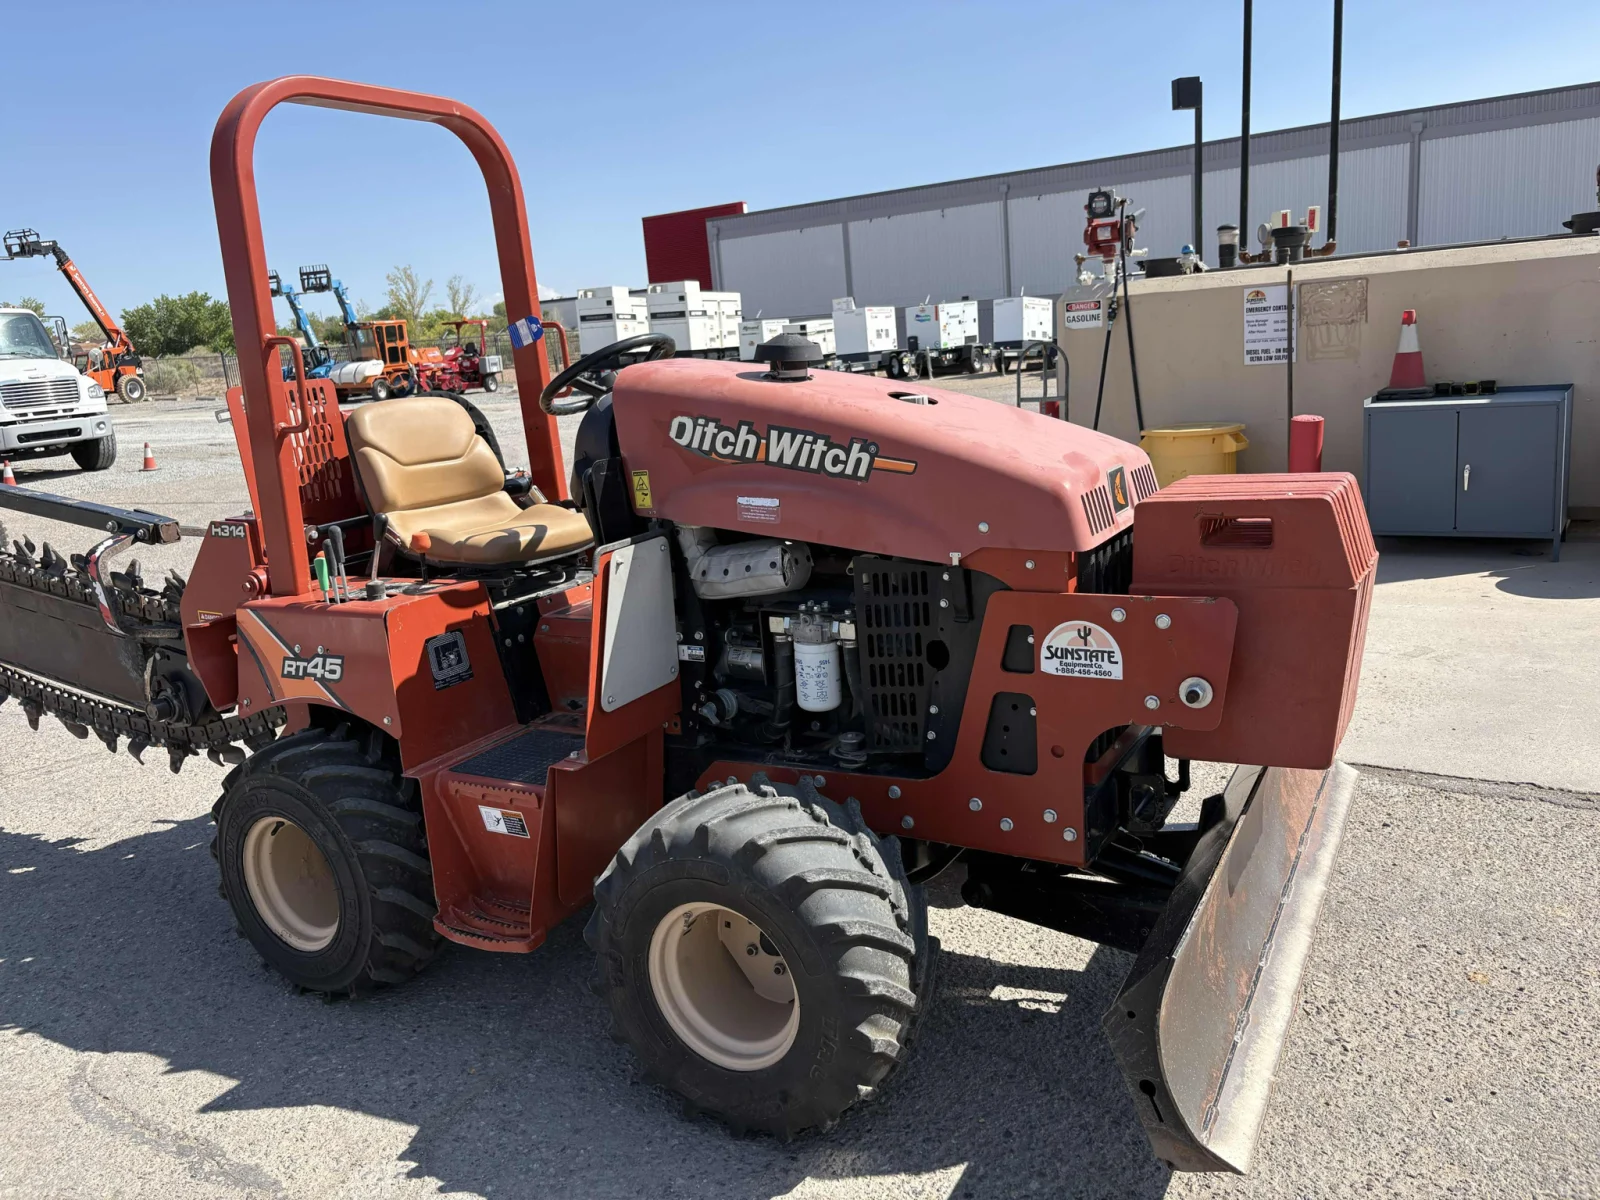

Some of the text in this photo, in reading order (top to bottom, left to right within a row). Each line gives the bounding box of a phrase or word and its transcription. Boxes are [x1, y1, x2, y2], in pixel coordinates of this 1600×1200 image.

[1071, 302, 1095, 311] DANGER
[1246, 305, 1271, 313] EMERGENCY
[1066, 313, 1101, 324] GASOLINE
[668, 415, 872, 478] Ditch Witch
[211, 524, 246, 538] H314
[1044, 645, 1119, 665] SUNSTATE
[283, 657, 343, 680] RT45
[1059, 660, 1104, 670] Equipment Co.
[1055, 667, 1113, 677] 1-888-456-4560
